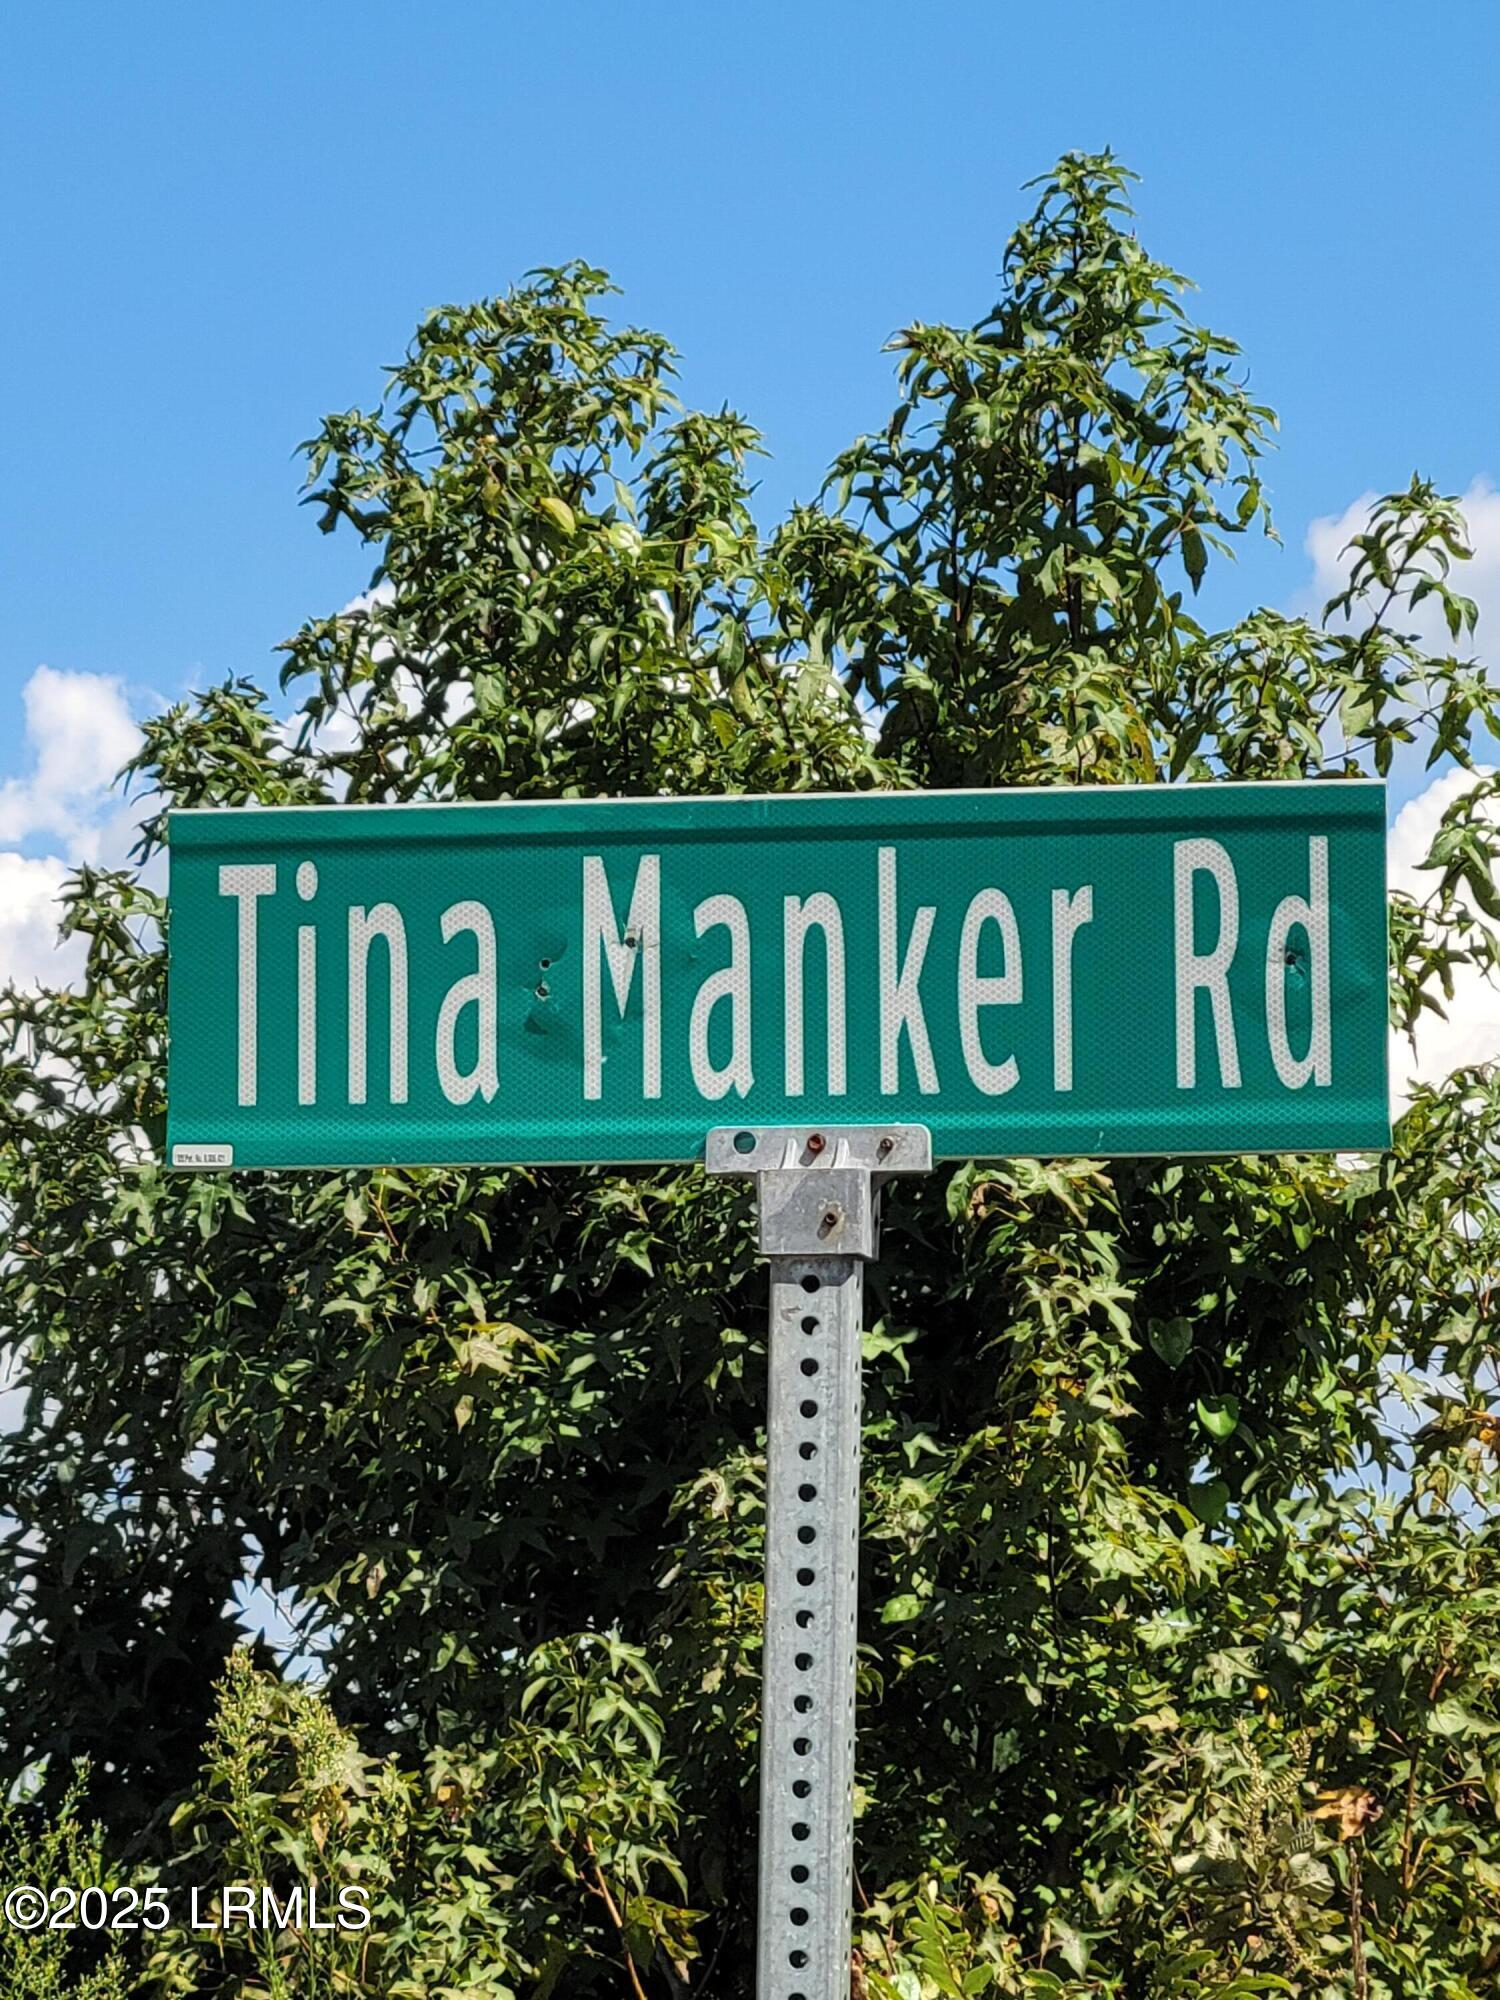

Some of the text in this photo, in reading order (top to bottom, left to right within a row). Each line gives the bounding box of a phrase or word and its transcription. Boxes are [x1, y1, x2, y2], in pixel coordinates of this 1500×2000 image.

[218, 836, 1333, 1106] Tina Manker Rd
